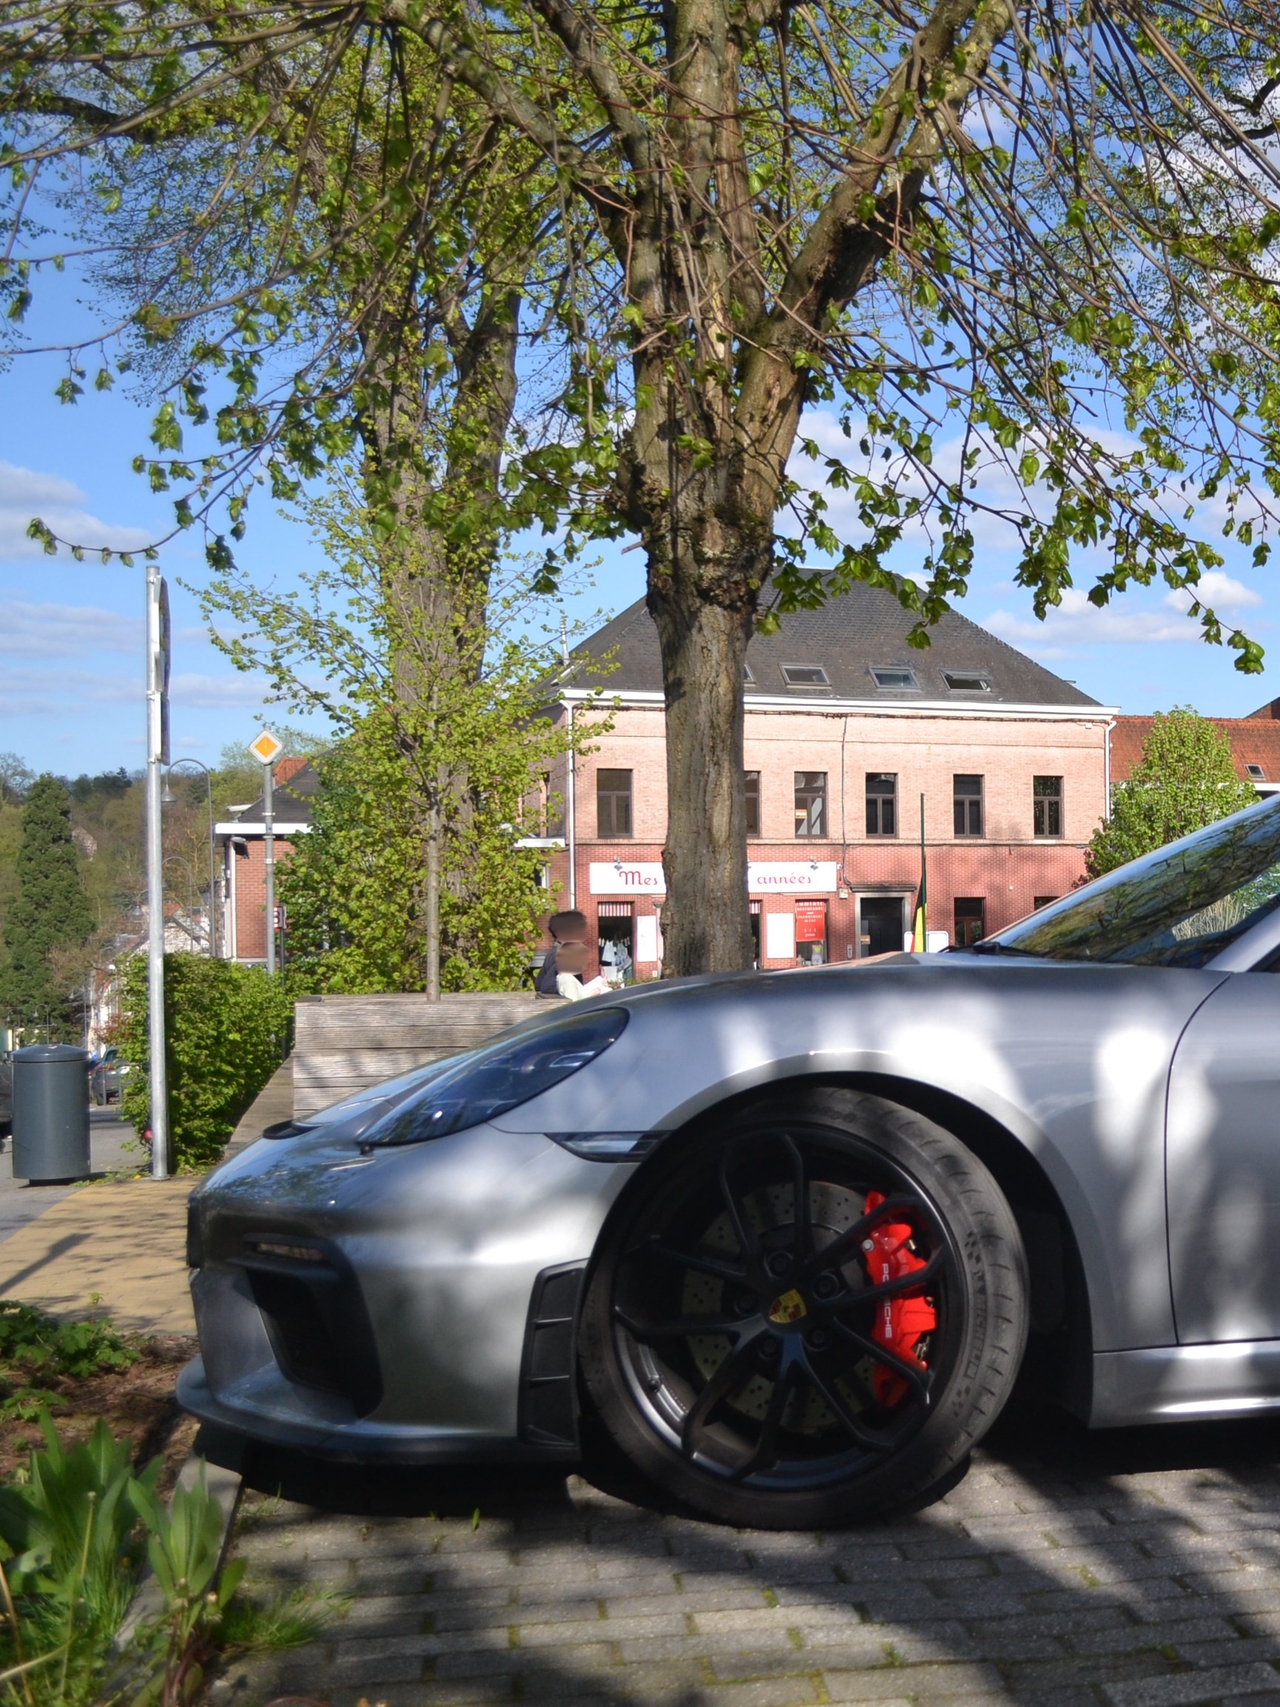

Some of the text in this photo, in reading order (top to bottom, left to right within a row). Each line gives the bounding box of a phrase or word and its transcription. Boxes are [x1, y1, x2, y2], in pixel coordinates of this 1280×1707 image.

[619, 870, 812, 885] Mes années
[964, 1291, 988, 1380] MICHELIN
